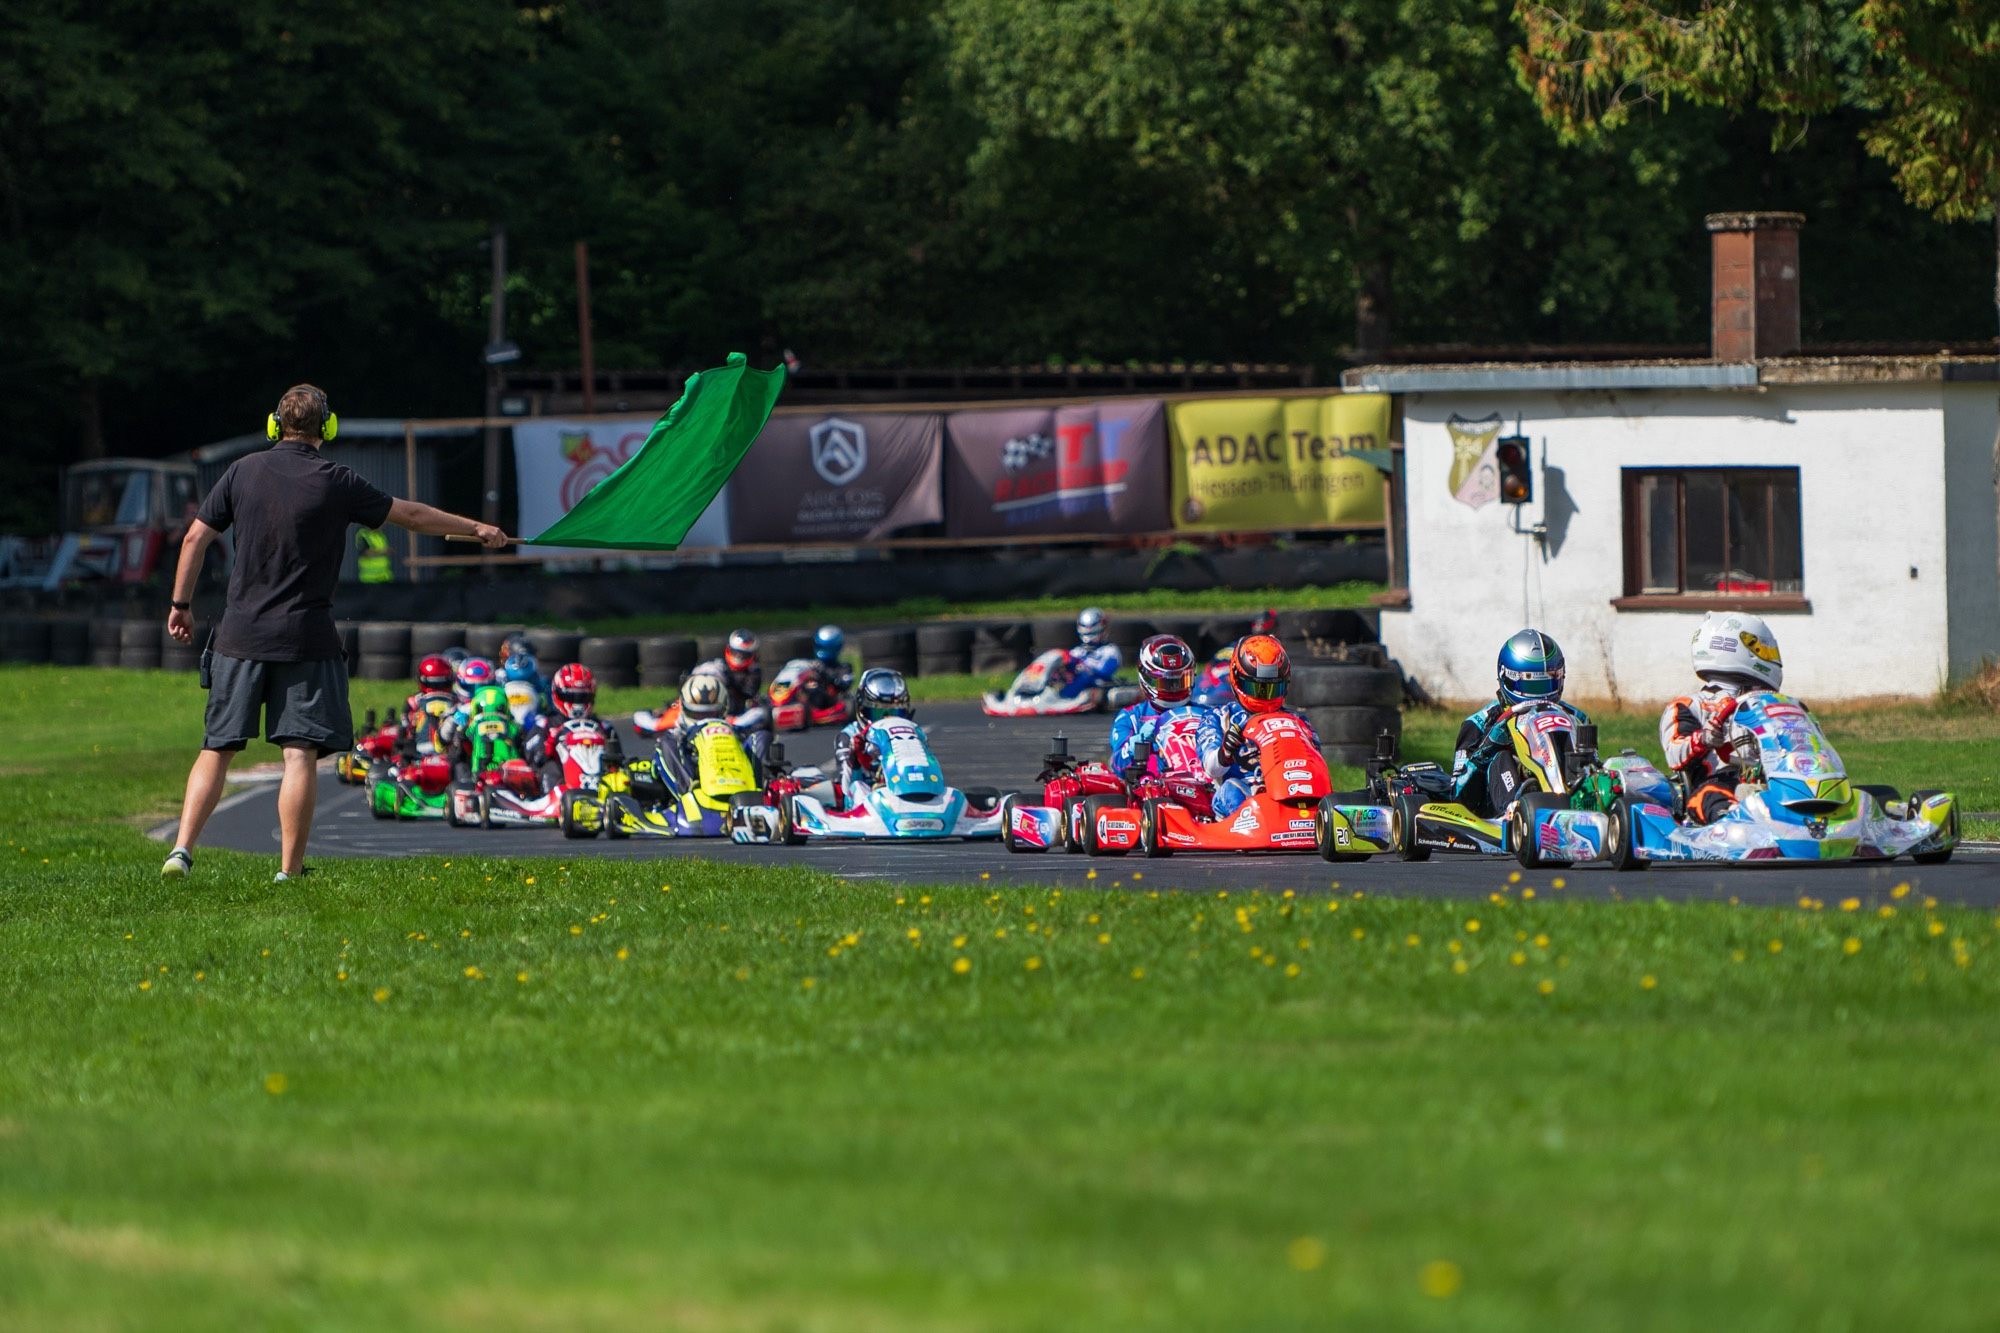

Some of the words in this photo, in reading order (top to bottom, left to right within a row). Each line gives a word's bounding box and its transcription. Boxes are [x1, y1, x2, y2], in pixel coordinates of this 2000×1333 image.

[1193, 431, 1281, 466] ADAC
[1292, 430, 1376, 463] Team
[1709, 635, 1738, 653] 22
[1267, 719, 1298, 731] 34
[1536, 716, 1572, 731] 20
[1291, 820, 1315, 829] Mach
[1336, 828, 1350, 845] 20
[1418, 838, 1450, 848] Schmetterling
[1453, 842, 1477, 850] Reisen.de
